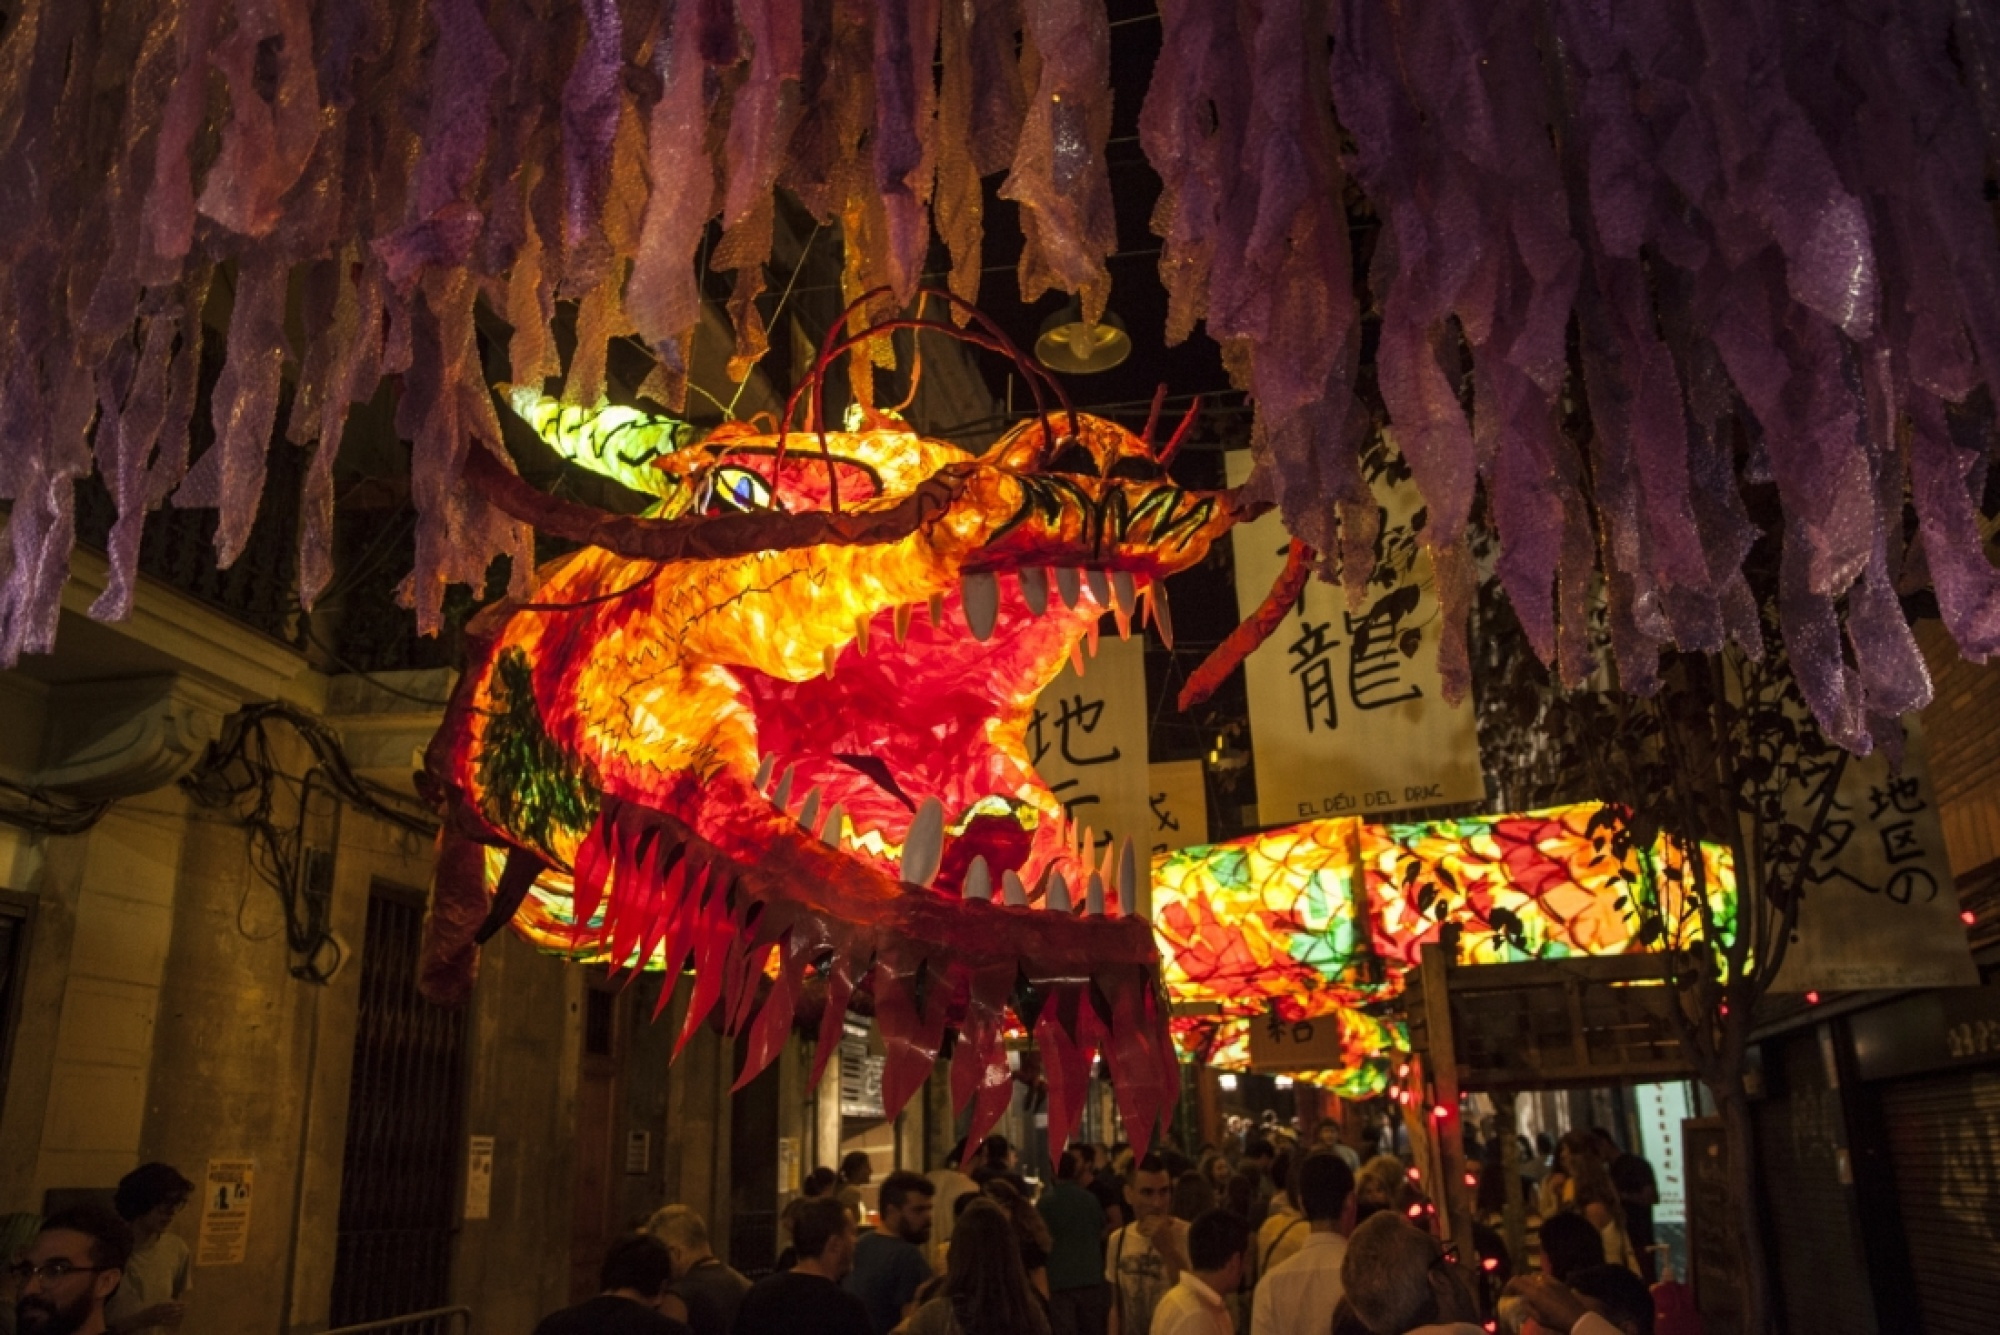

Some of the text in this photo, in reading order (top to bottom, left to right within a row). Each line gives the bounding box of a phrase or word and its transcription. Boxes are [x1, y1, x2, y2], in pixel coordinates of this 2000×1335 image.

[1298, 801, 1320, 817] EL
[1323, 792, 1356, 813] DÉU
[1363, 790, 1397, 807] DEL
[1867, 726, 1939, 904] 地区の
